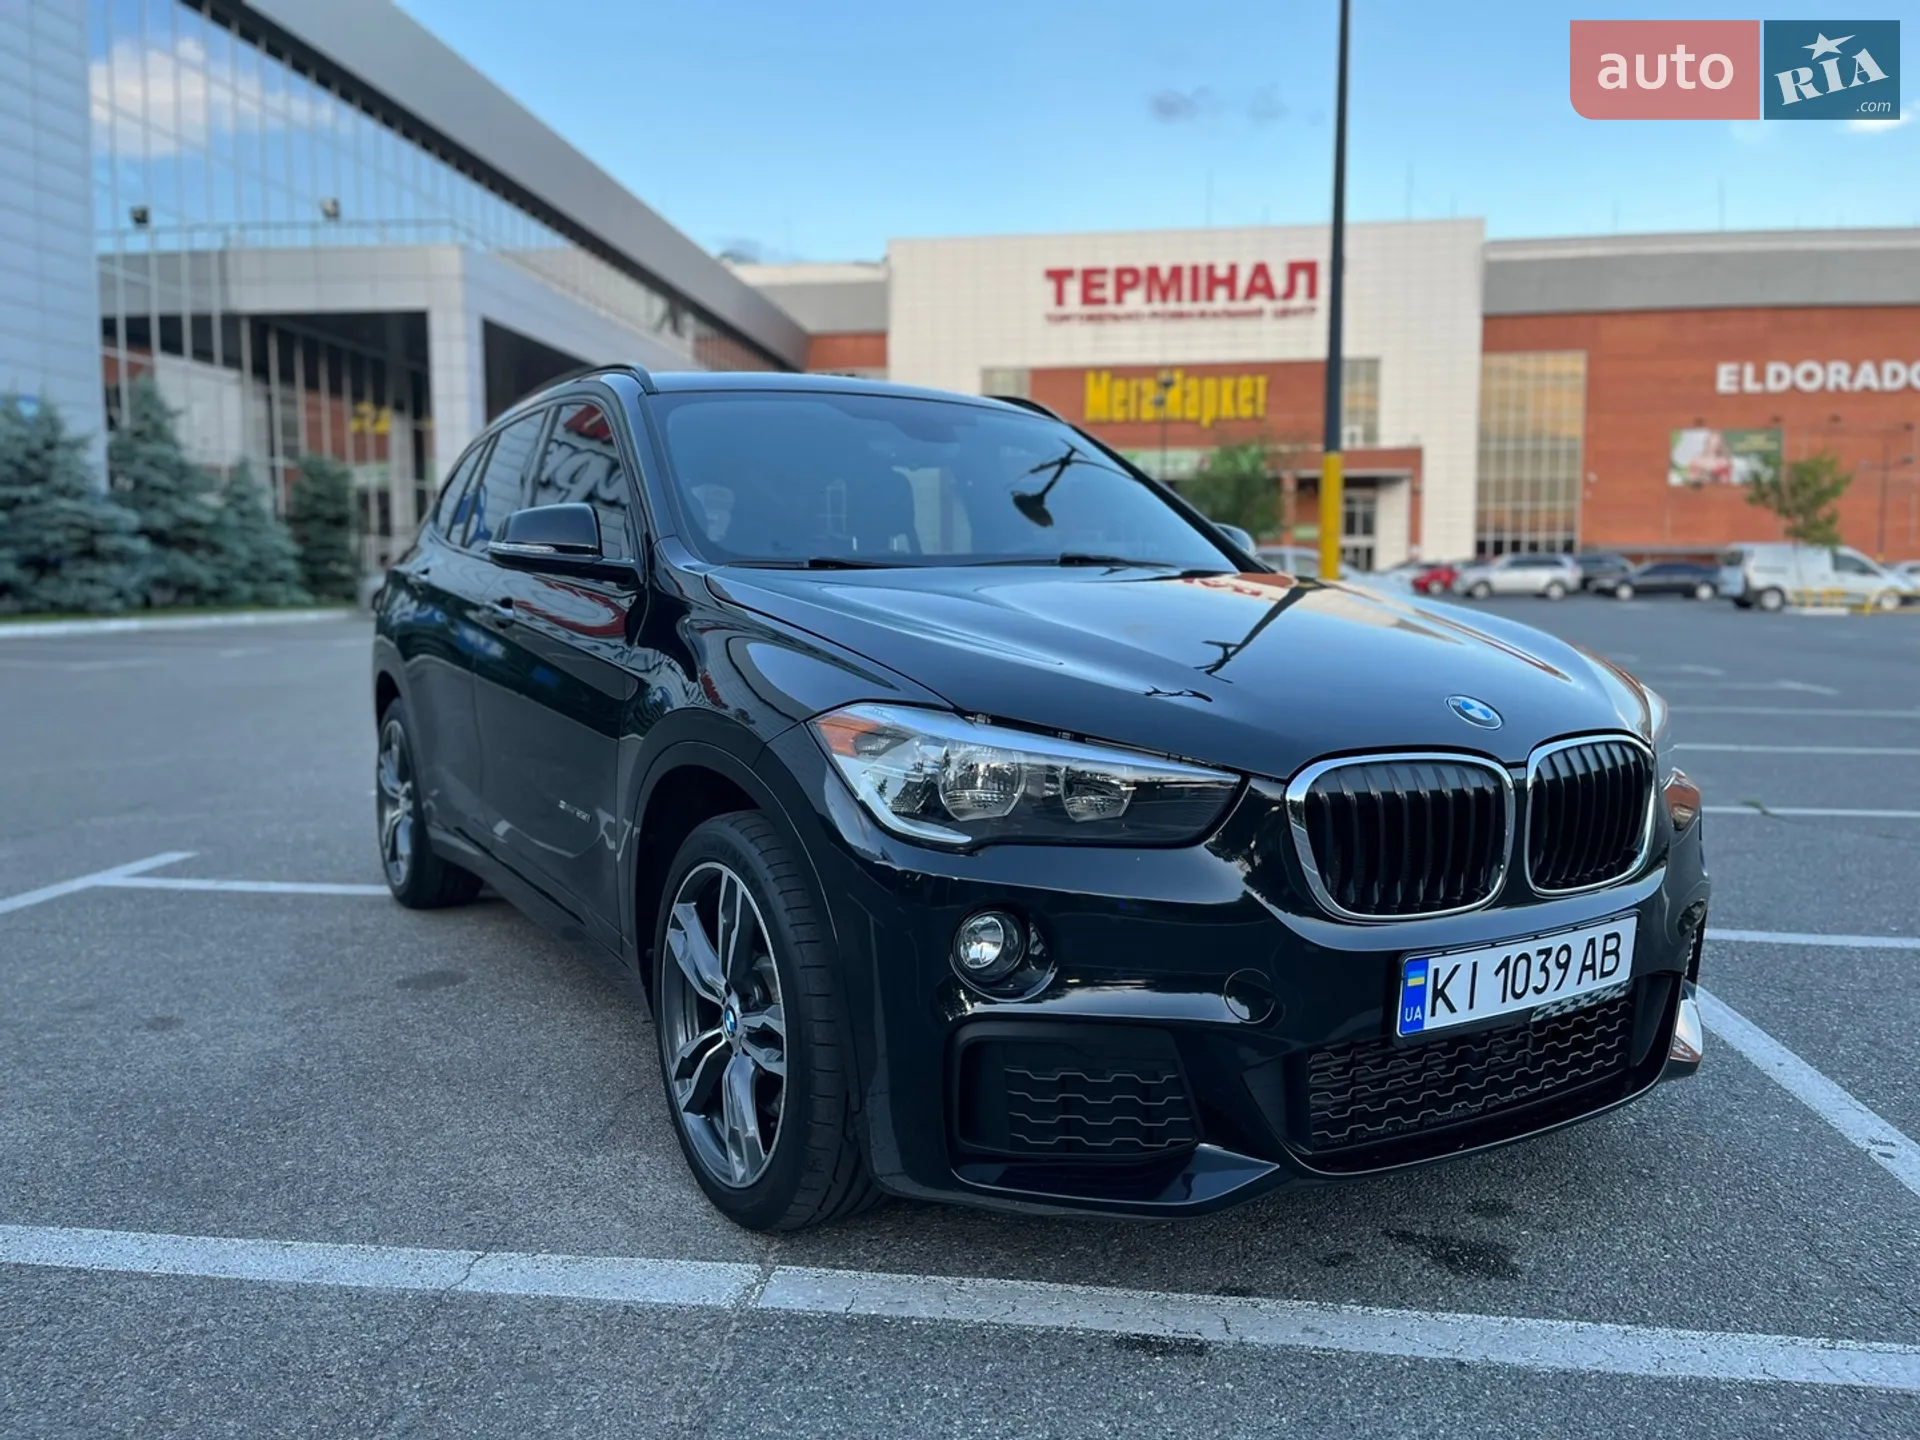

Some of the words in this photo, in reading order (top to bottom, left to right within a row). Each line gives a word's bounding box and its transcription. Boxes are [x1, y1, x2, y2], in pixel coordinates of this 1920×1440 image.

[1045, 260, 1319, 307] ТЕРМІНАЛ
[1430, 960, 1479, 1018] KI
[1493, 943, 1572, 1004] 1039
[1576, 931, 1622, 986] AB
[1404, 1006, 1423, 1023] UA
